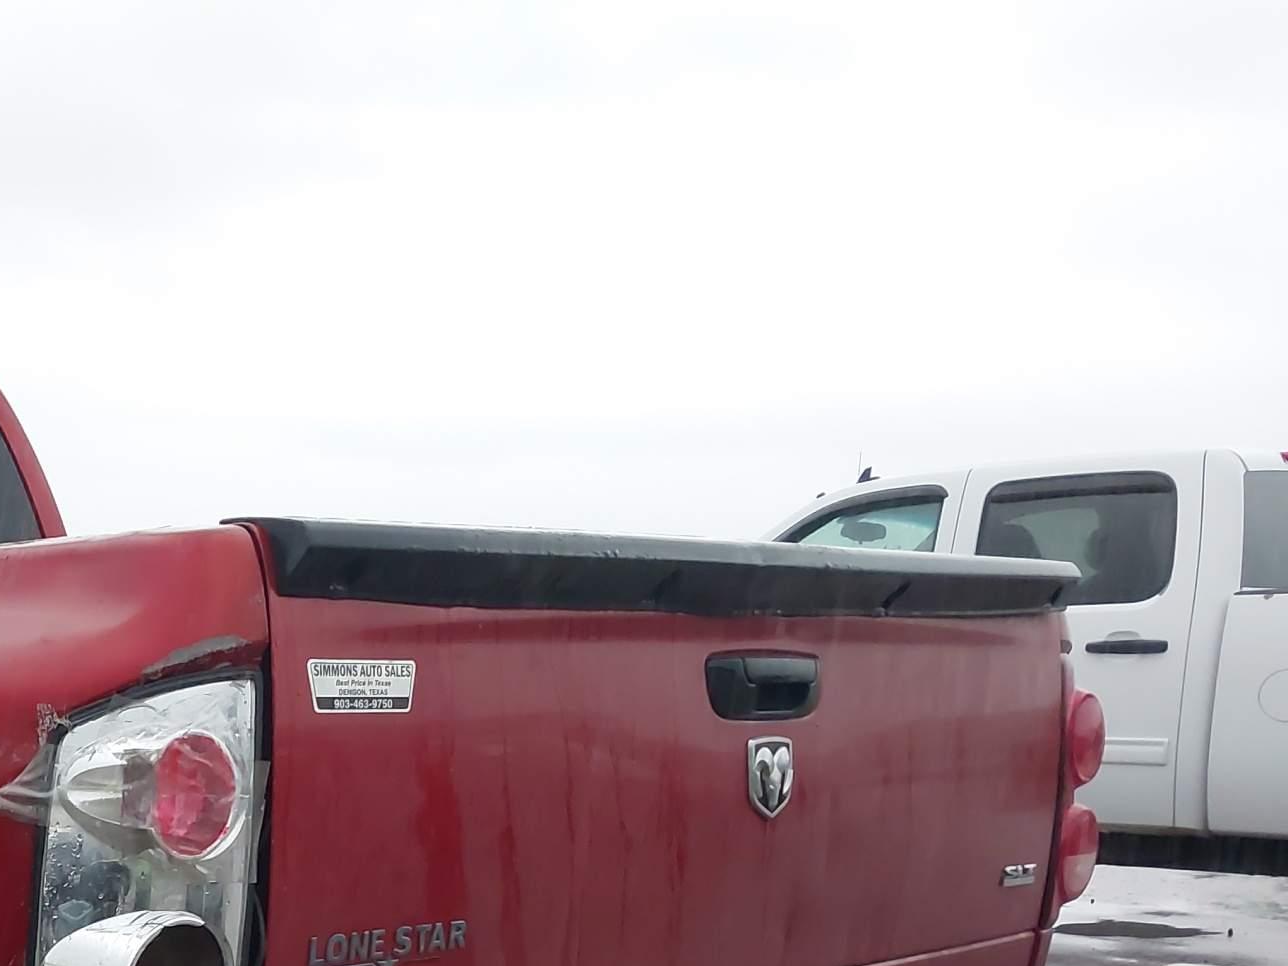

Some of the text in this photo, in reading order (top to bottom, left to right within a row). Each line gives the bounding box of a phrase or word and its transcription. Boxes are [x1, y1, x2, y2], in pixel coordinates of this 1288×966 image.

[314, 664, 411, 677] SIMMONS AUTO SALES
[333, 698, 393, 709] 903-463-9750
[308, 920, 465, 965] LONE STAR
